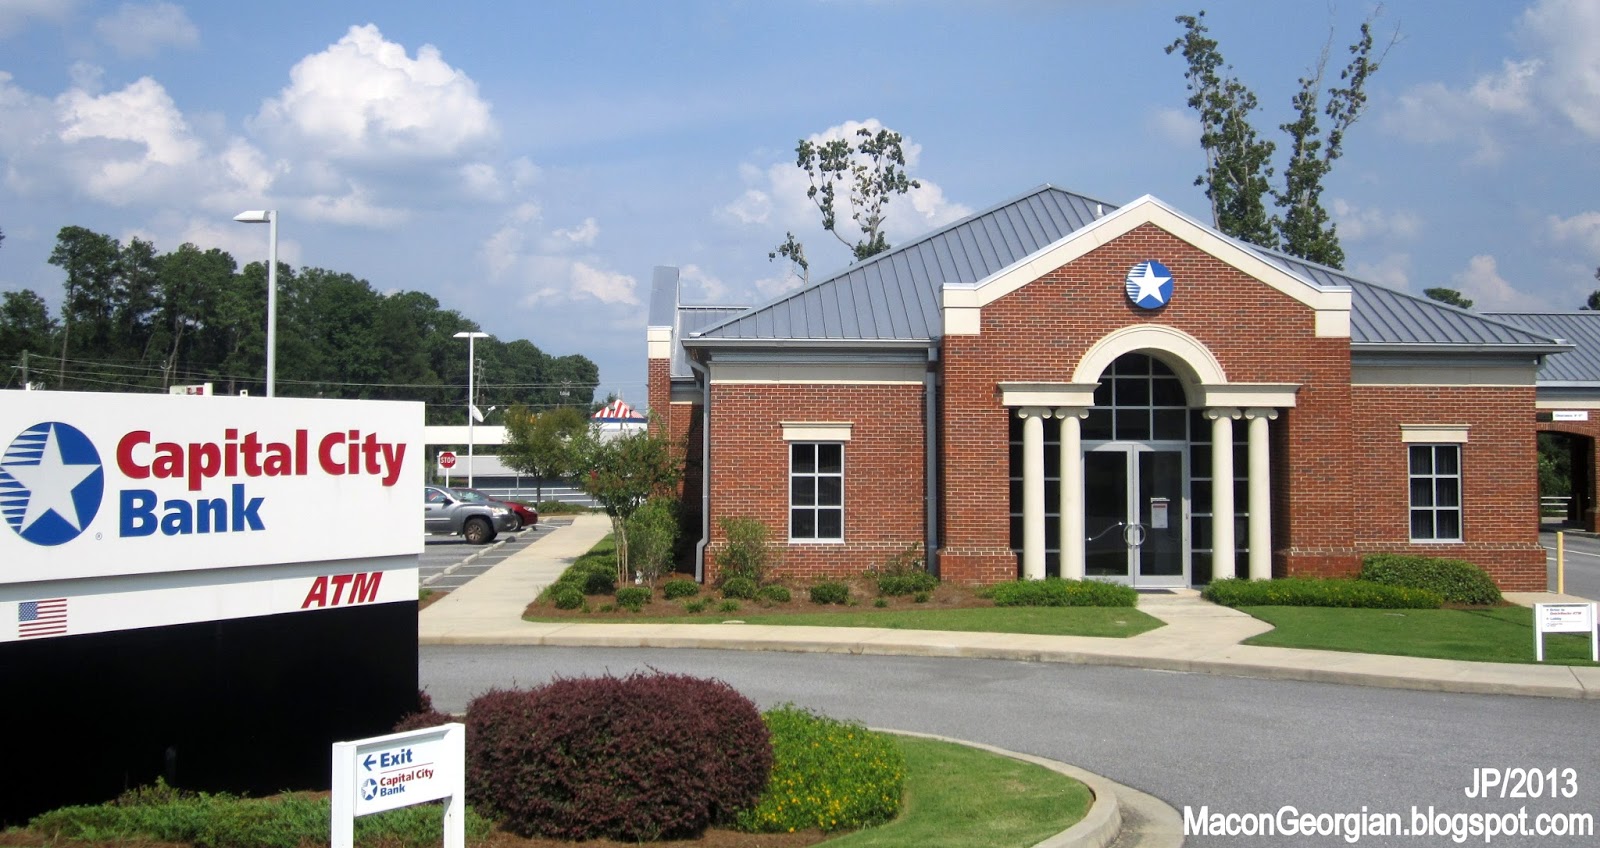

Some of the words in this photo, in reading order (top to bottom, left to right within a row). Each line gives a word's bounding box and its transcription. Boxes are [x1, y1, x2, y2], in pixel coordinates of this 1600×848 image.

[116, 429, 308, 491] Capital
[318, 429, 406, 487] City
[440, 456, 455, 464] STOP
[119, 483, 266, 538] Bank
[301, 571, 383, 609] ATM
[380, 748, 413, 768] Exit
[380, 771, 414, 787] Capital
[416, 769, 434, 779] City
[380, 784, 406, 797] Bank
